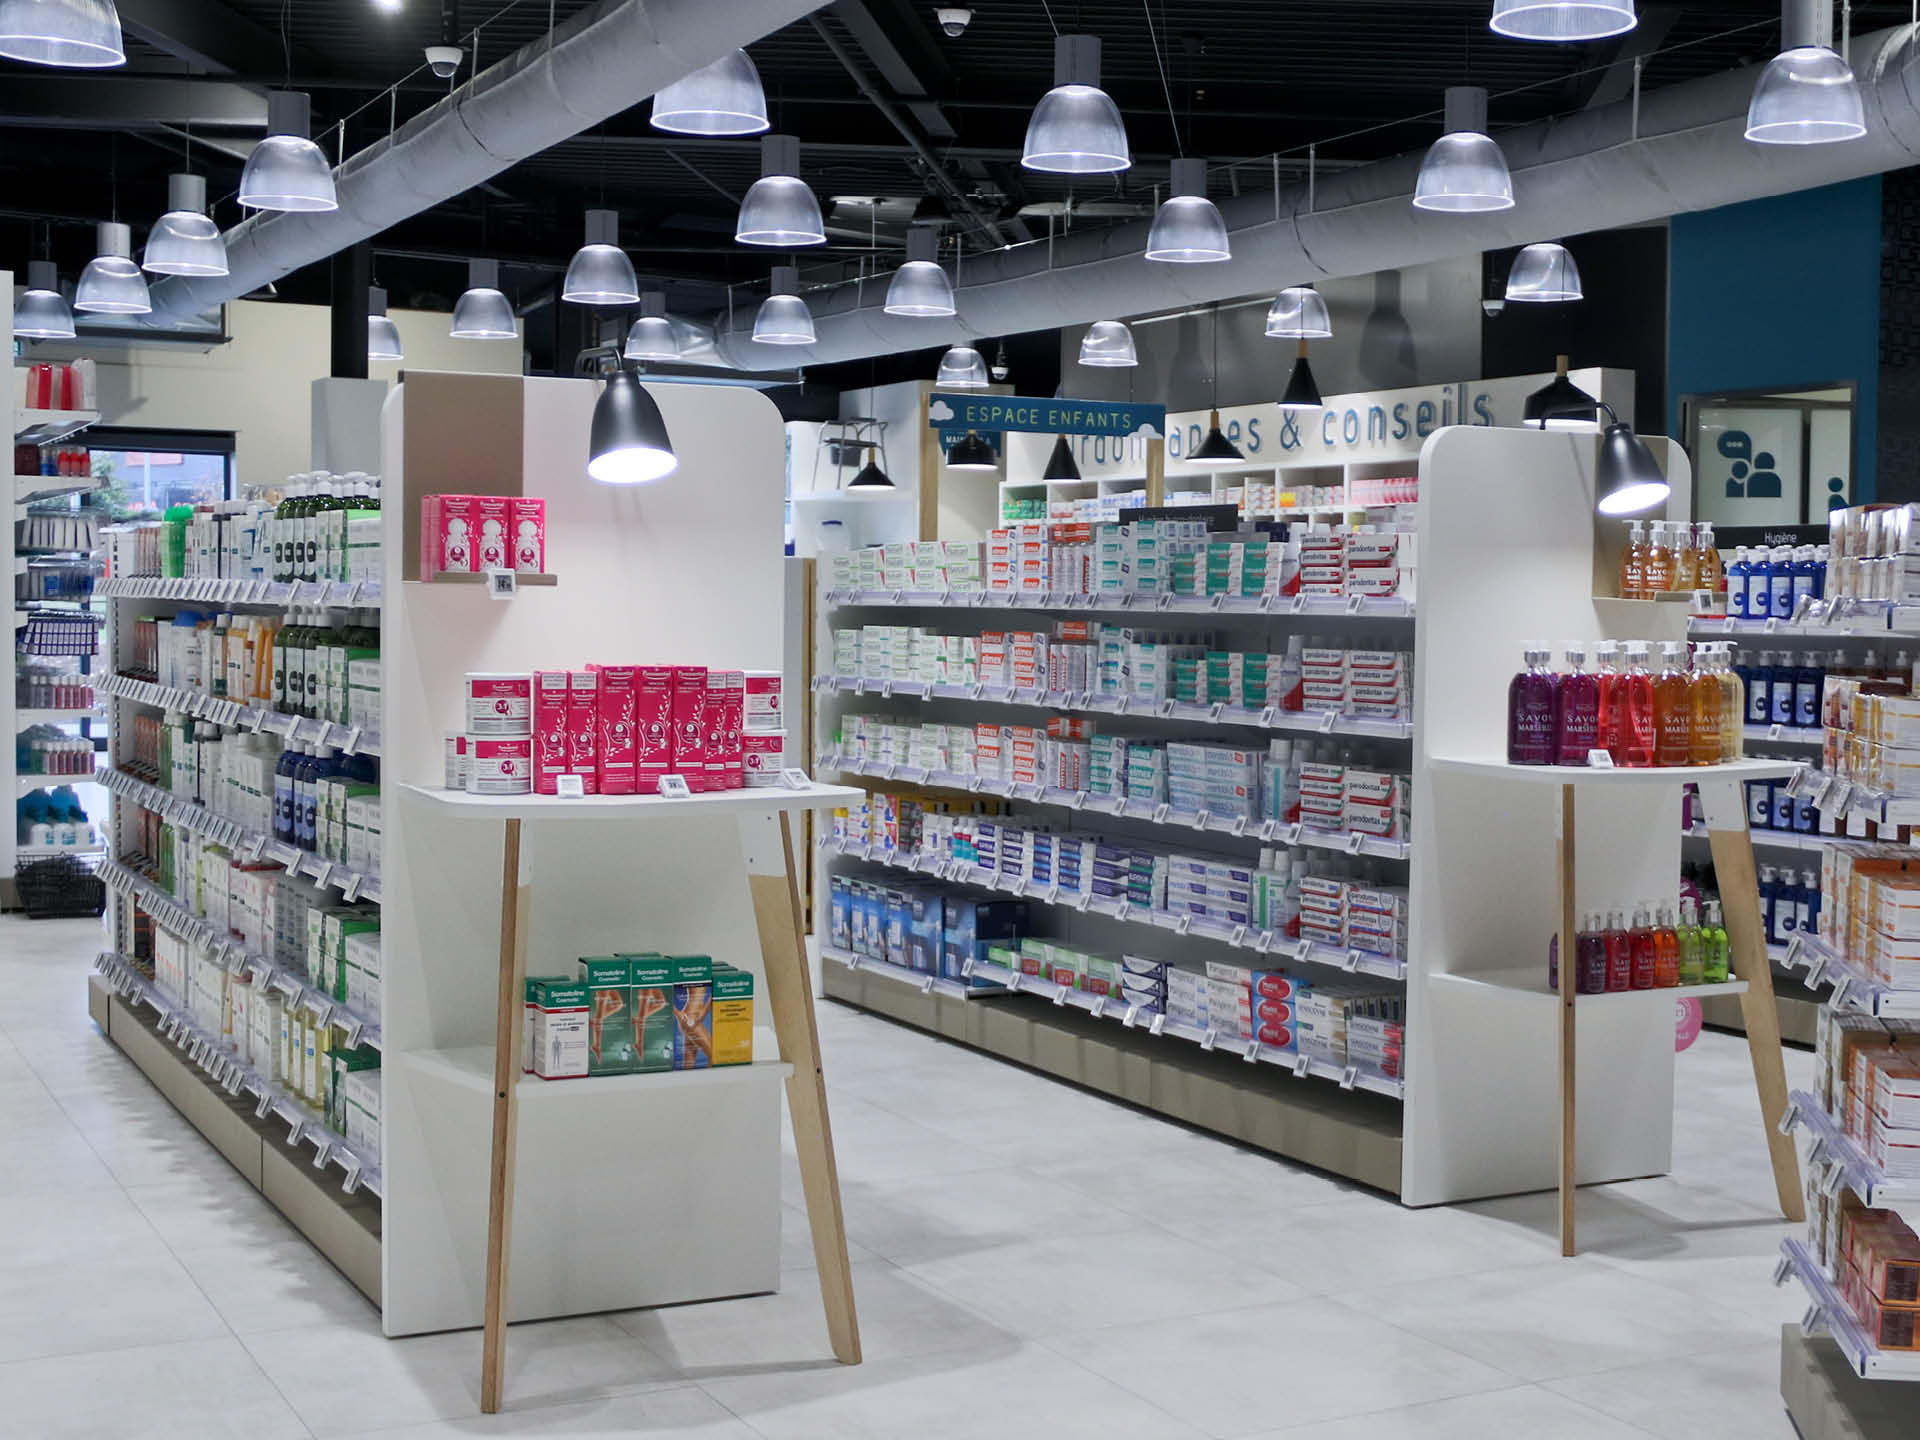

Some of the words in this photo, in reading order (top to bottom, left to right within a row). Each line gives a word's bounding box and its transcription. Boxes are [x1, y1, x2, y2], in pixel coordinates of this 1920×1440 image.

[967, 406, 1039, 424] ESPACE
[1049, 409, 1133, 430] ENFANTS
[1280, 408, 1303, 450] &
[1322, 383, 1493, 446] conseils
[1764, 532, 1798, 545] Hygiène
[1349, 544, 1376, 553] parodontax
[1349, 579, 1376, 589] parodontax
[1350, 782, 1380, 792] parodontax
[1350, 815, 1380, 826] parodontax
[593, 969, 625, 977] Somatoline
[637, 968, 669, 976] Somatoline
[717, 980, 750, 988] Somatoline
[551, 990, 585, 998] Somatoline
